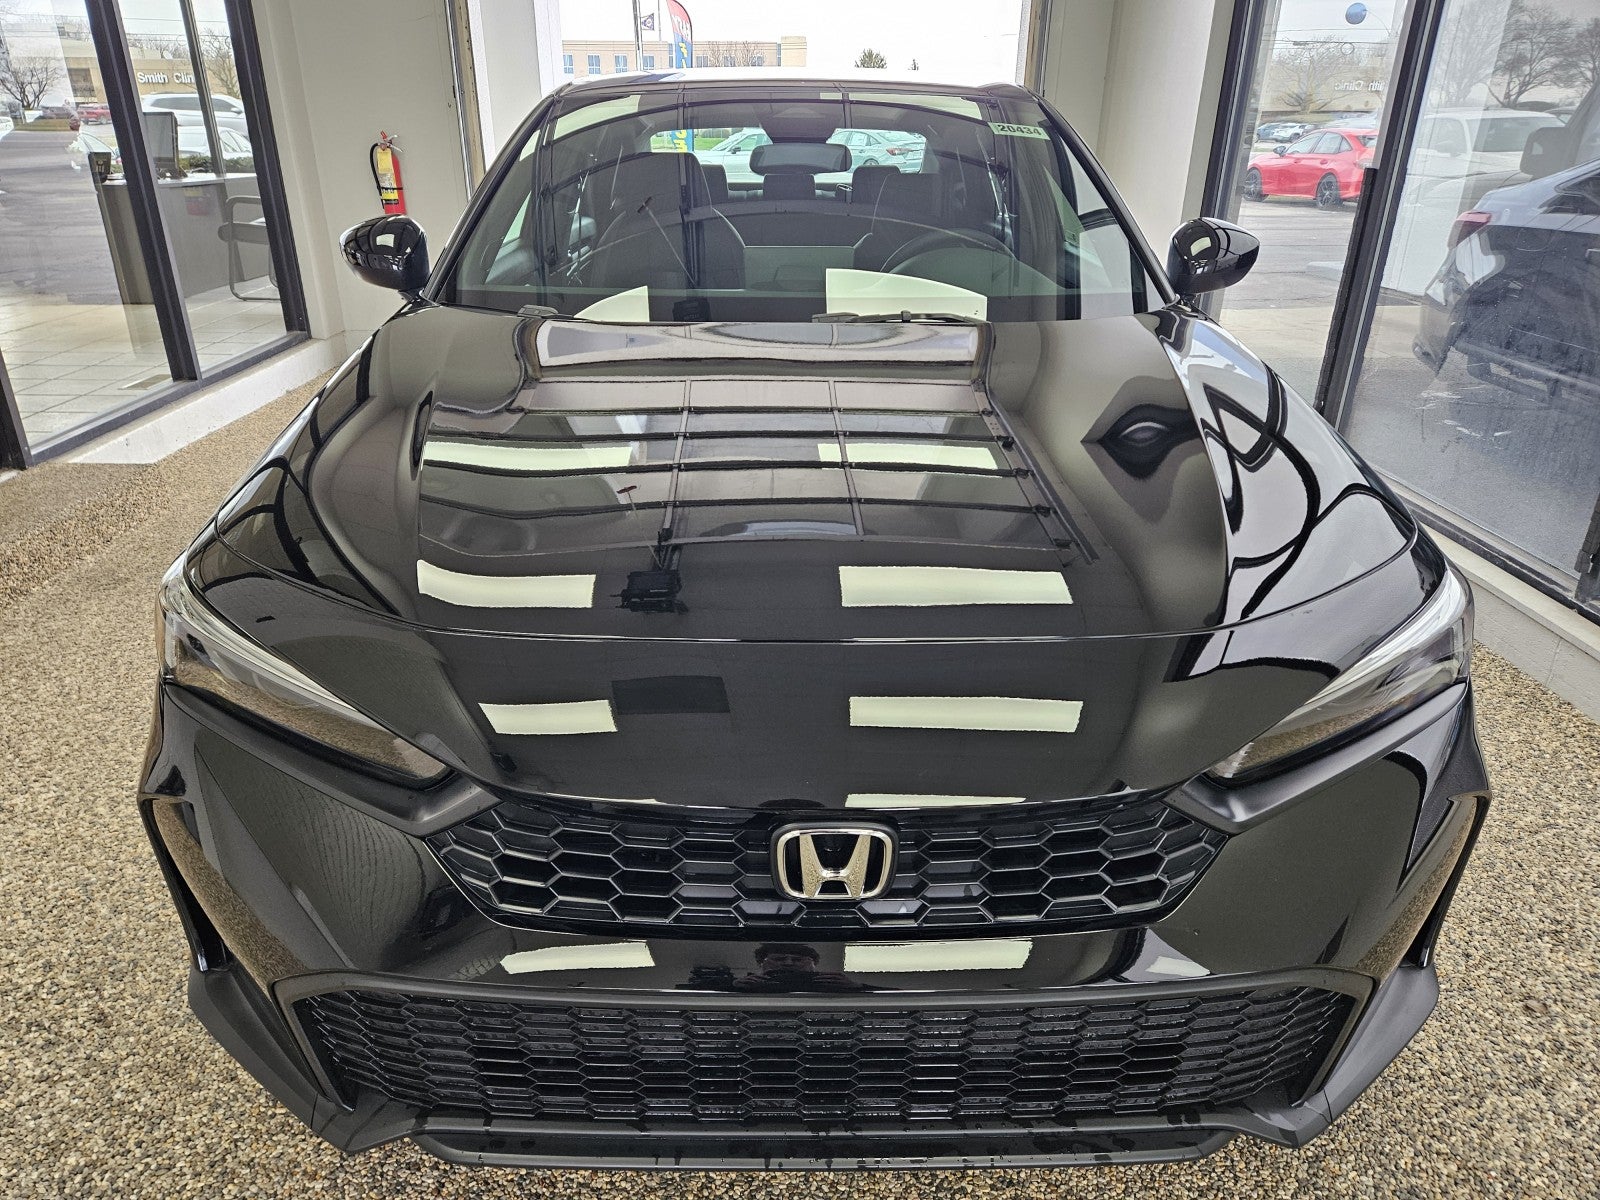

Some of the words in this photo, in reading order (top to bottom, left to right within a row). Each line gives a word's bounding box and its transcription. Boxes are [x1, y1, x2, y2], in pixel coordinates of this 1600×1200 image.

[137, 72, 168, 83] Smith
[174, 72, 195, 83] Clin
[997, 124, 1041, 135] 20434
